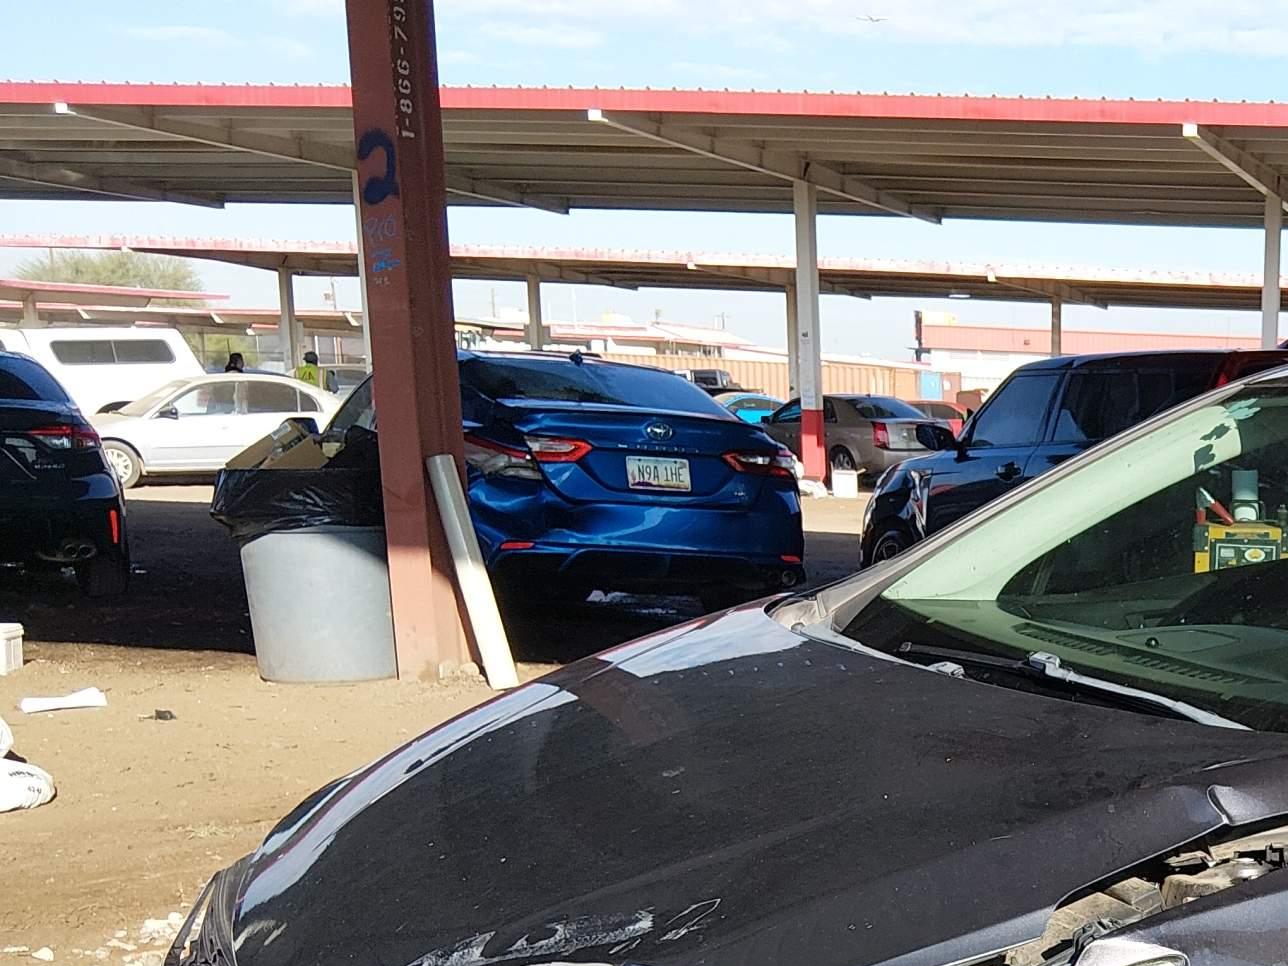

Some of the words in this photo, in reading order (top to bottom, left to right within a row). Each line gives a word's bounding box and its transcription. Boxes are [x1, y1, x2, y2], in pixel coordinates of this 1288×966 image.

[393, 0, 415, 138] 1-866-79
[357, 128, 399, 205] 2
[637, 464, 660, 481] N9A
[664, 466, 684, 483] 1HE
